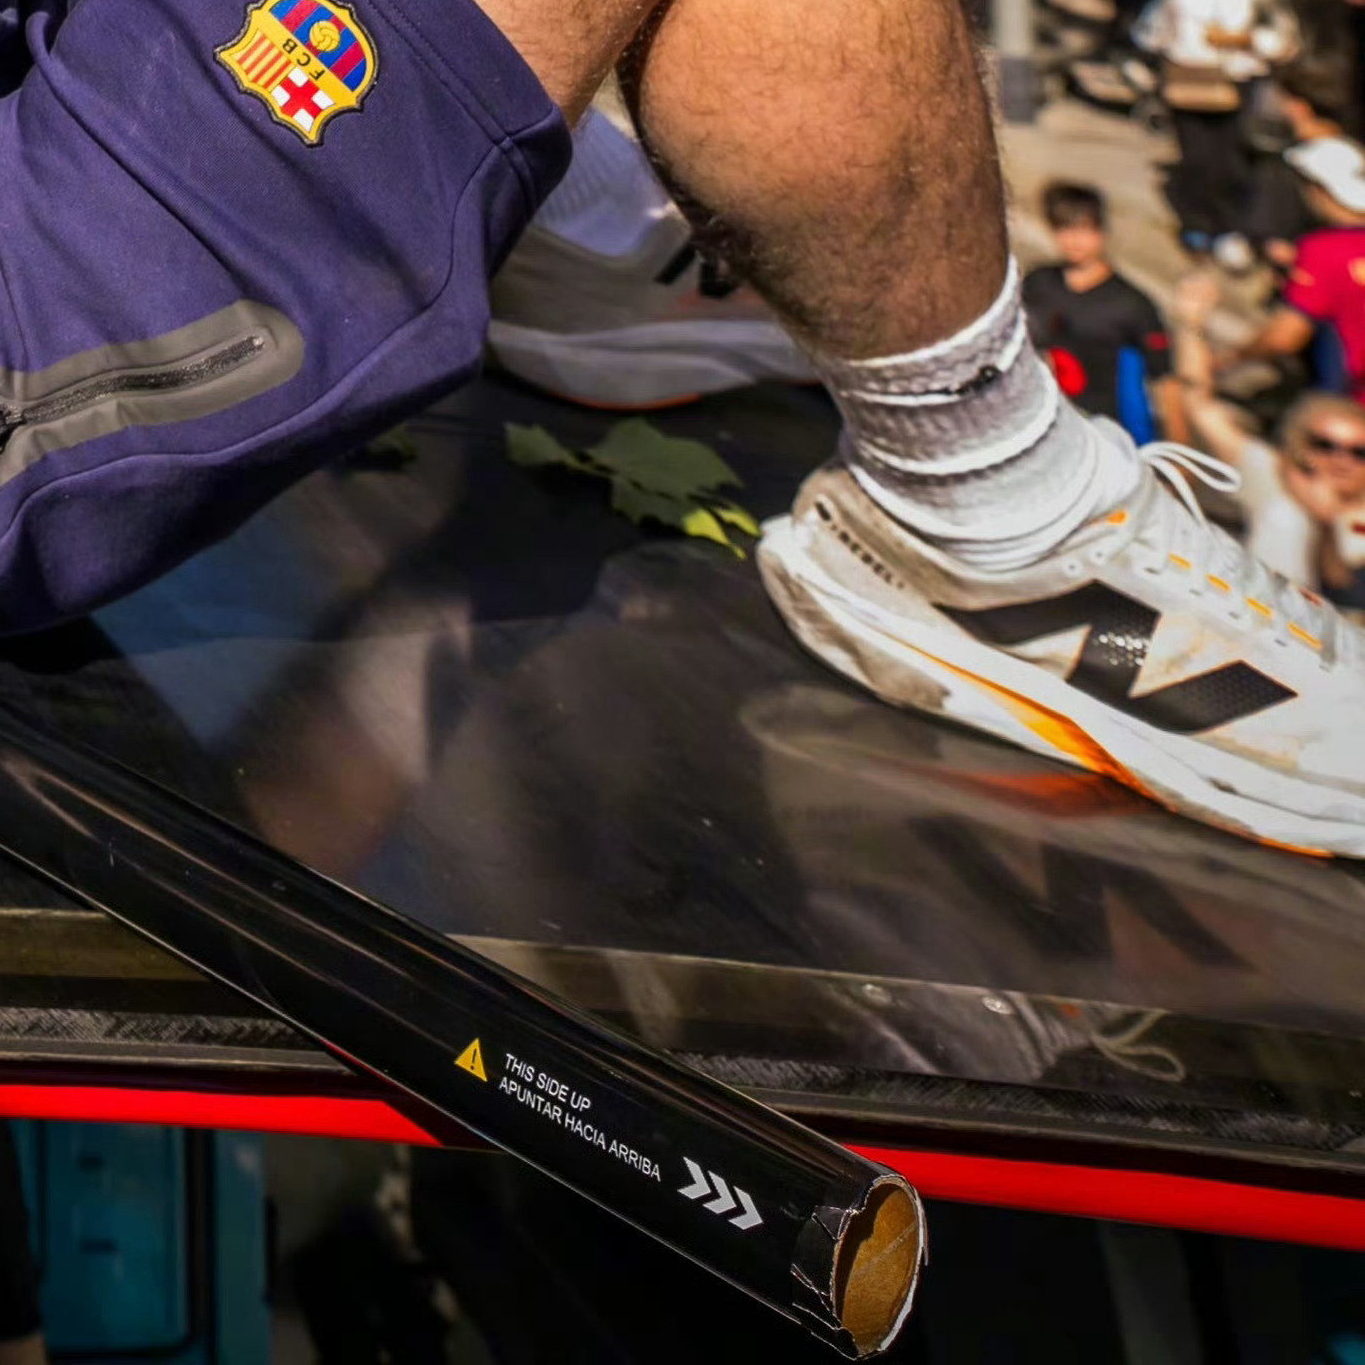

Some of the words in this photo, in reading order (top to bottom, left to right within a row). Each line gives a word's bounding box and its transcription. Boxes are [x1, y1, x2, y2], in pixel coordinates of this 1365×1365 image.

[282, 38, 326, 81] FCB
[505, 1053, 536, 1082] THIS
[536, 1072, 570, 1103] SIDE
[570, 1090, 591, 1113] UP
[499, 1076, 562, 1125] APUNTAR
[564, 1112, 606, 1150] HACIA
[608, 1139, 662, 1182] ARRIBA
